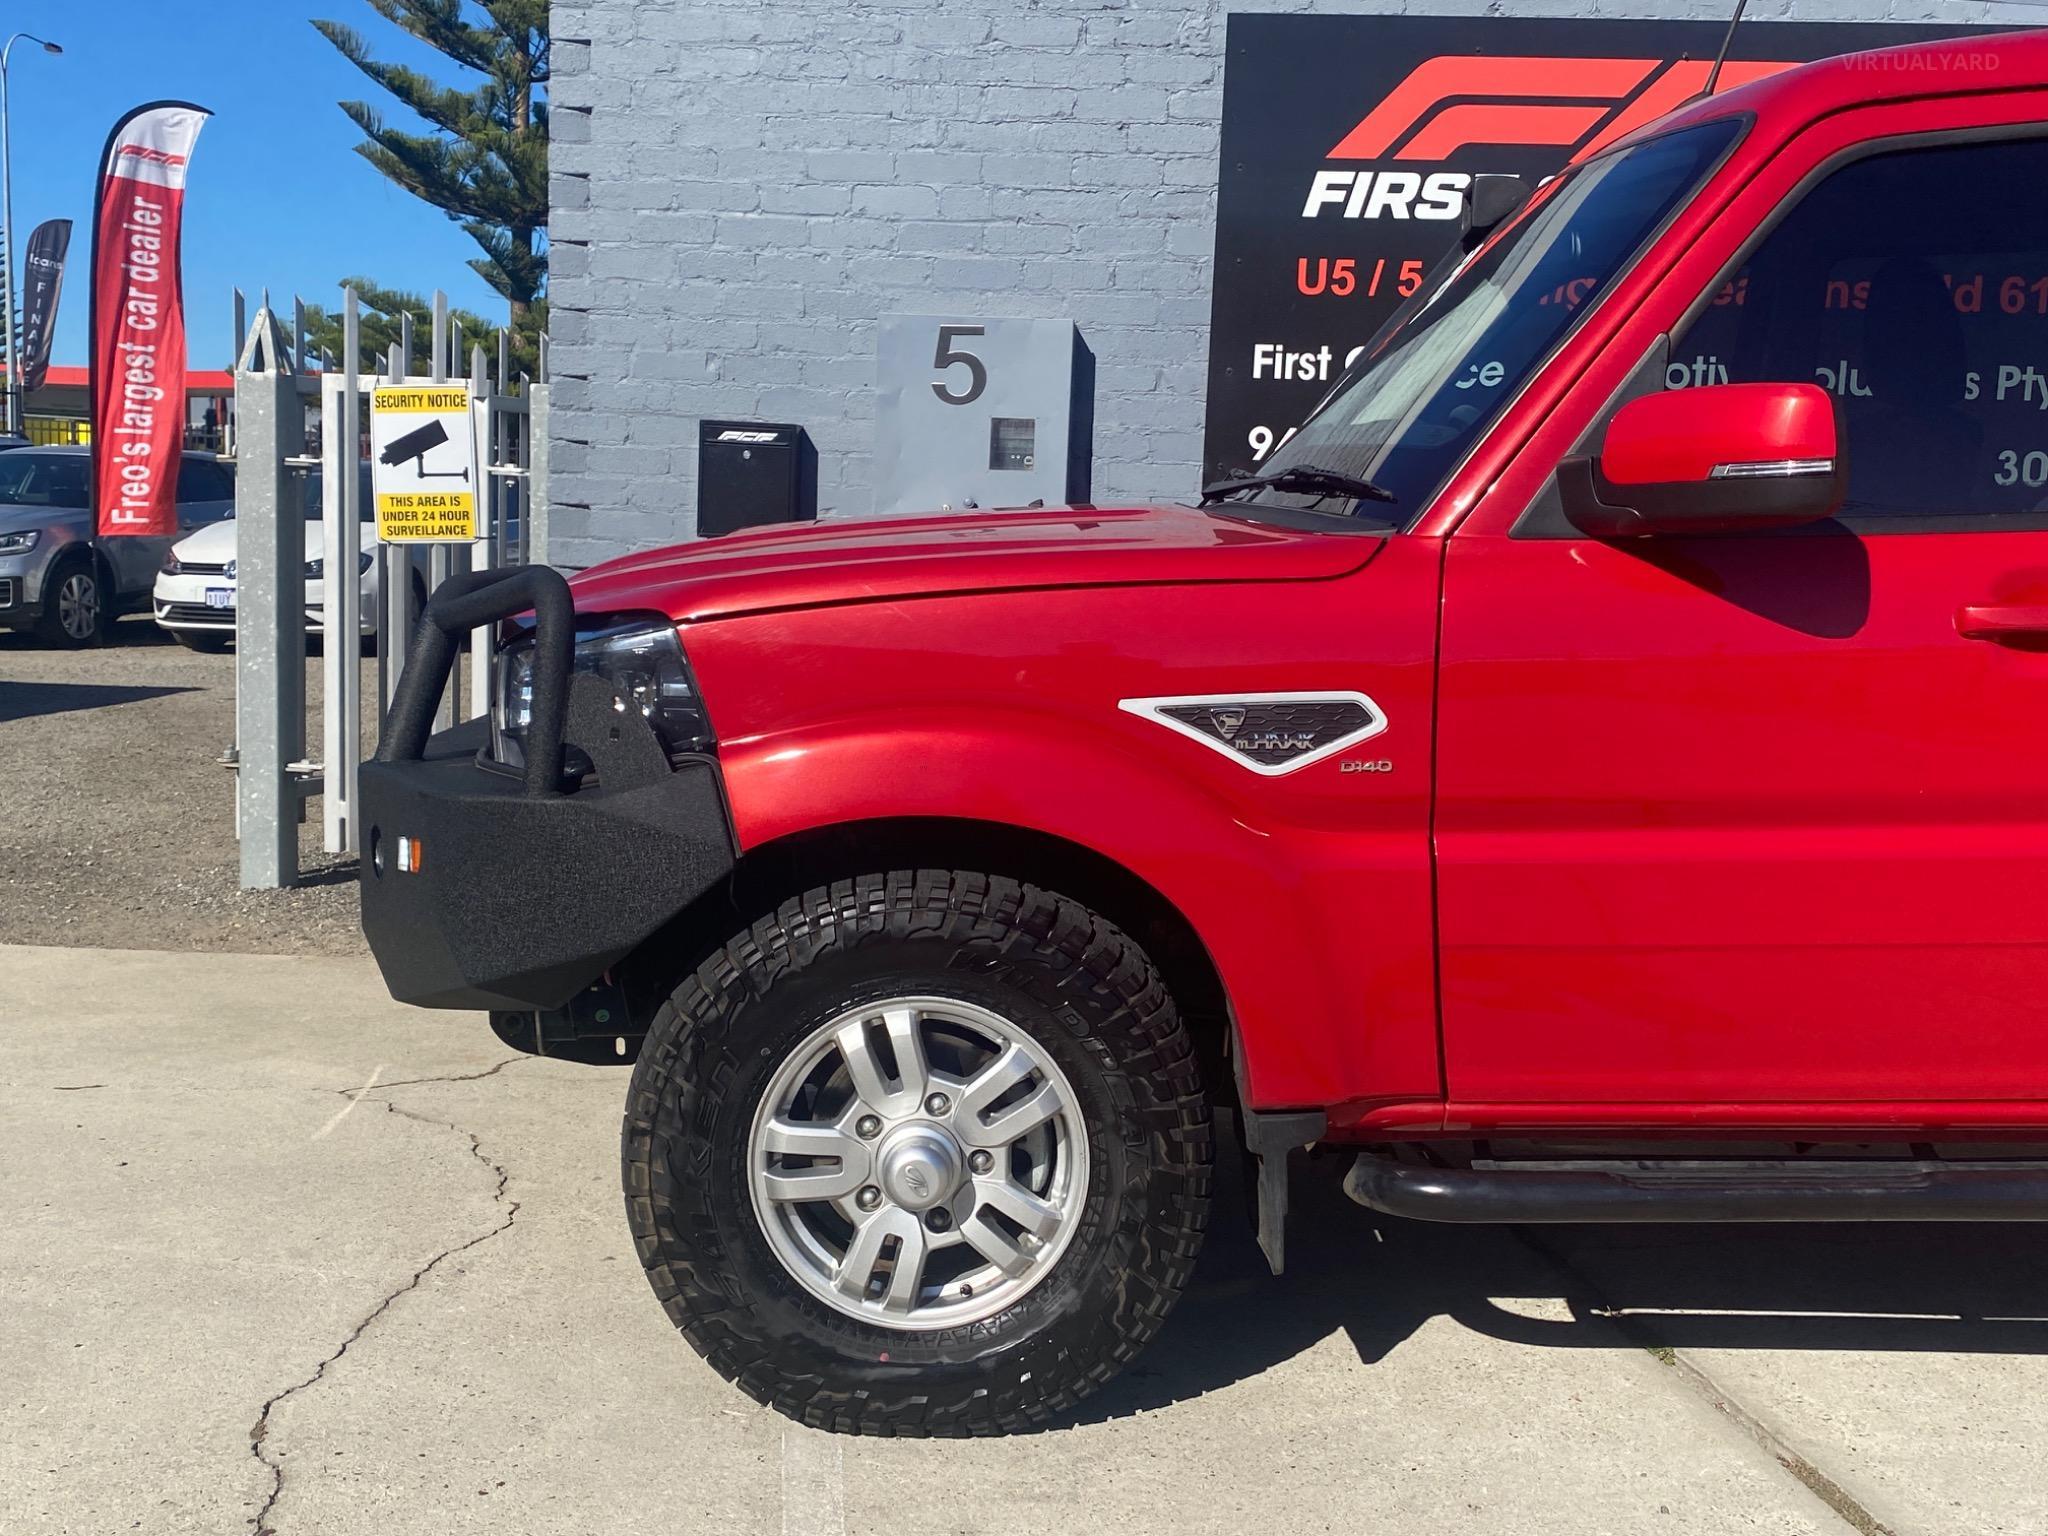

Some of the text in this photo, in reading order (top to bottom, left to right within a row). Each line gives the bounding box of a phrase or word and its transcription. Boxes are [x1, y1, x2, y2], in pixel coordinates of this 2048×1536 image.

[1302, 171, 1520, 220] FIRS
[121, 196, 163, 281] dealer
[1297, 258, 1356, 296] U5
[1368, 259, 1385, 296] /
[127, 290, 158, 330] car
[931, 324, 987, 405] 5
[1252, 343, 1332, 381] First
[113, 342, 164, 435] largest
[375, 394, 467, 408] SECURITY NOTICE
[111, 441, 151, 525] Freo's
[389, 495, 461, 507] THIS AREA IS
[382, 510, 470, 522] UNDER 24 HOUR
[387, 525, 467, 536] SURVEILLANCE
